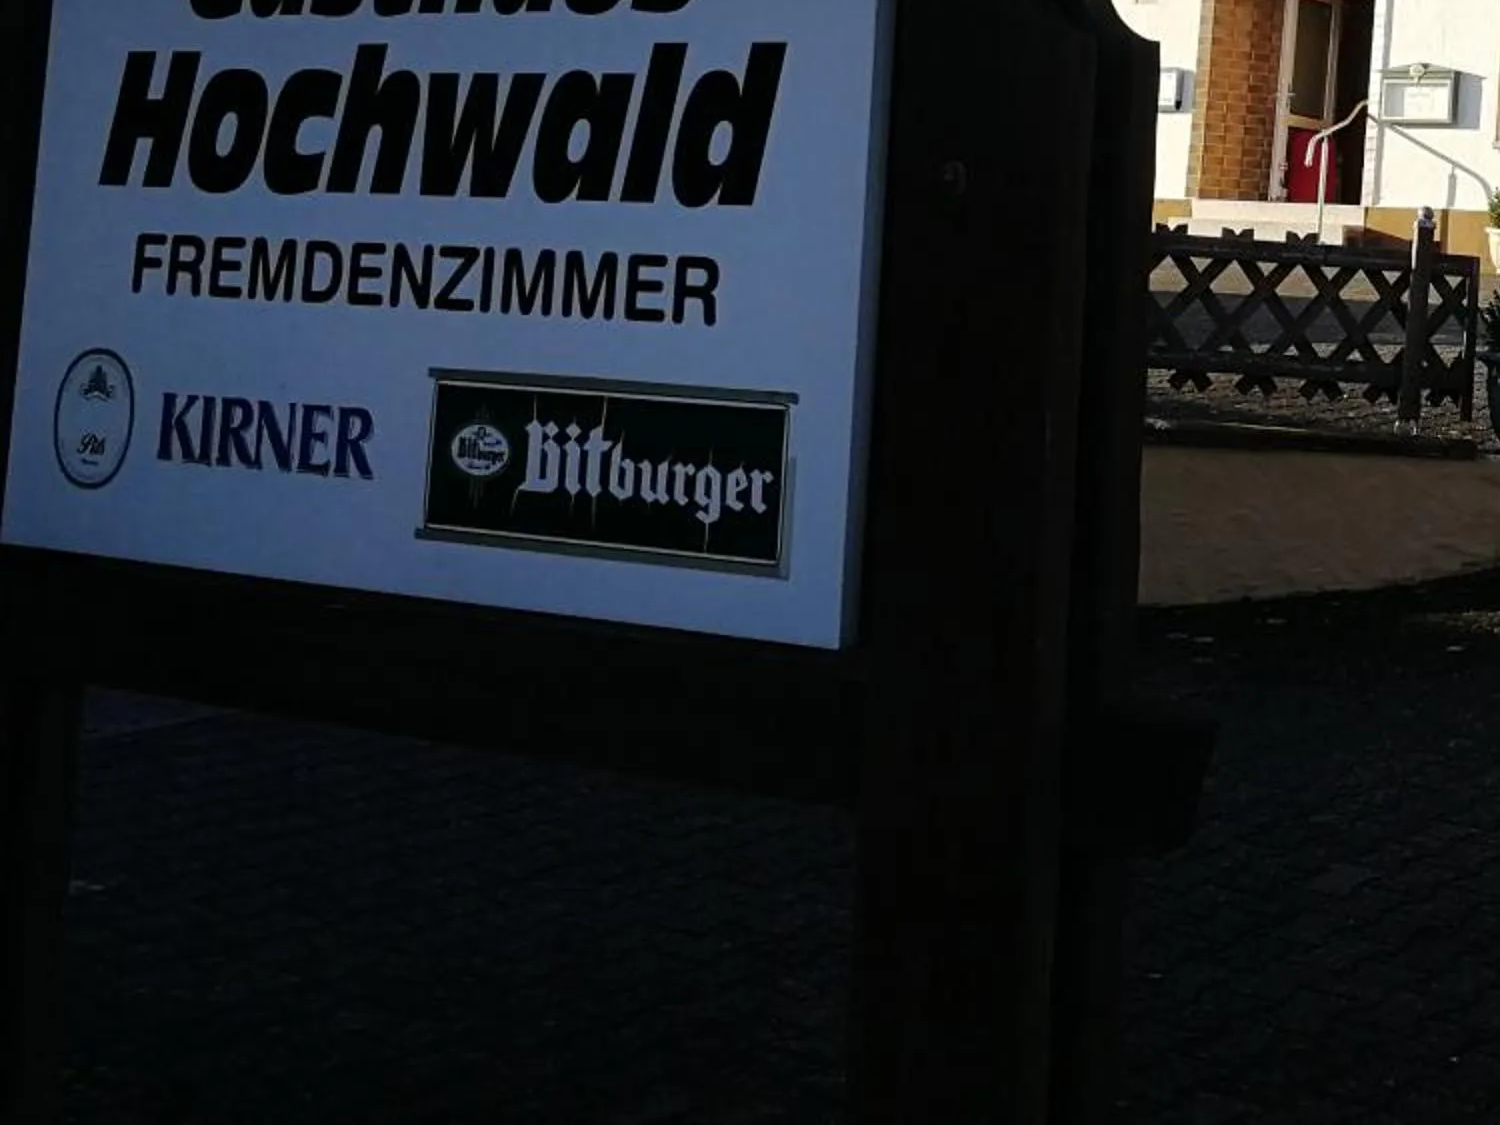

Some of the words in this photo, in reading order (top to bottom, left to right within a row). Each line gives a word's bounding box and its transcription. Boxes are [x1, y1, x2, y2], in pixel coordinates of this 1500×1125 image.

[98, 41, 788, 208] Hochwald
[131, 232, 722, 327] FREMDENZIMMER
[156, 391, 376, 480] KIRNER
[514, 416, 776, 526] Bitburger
